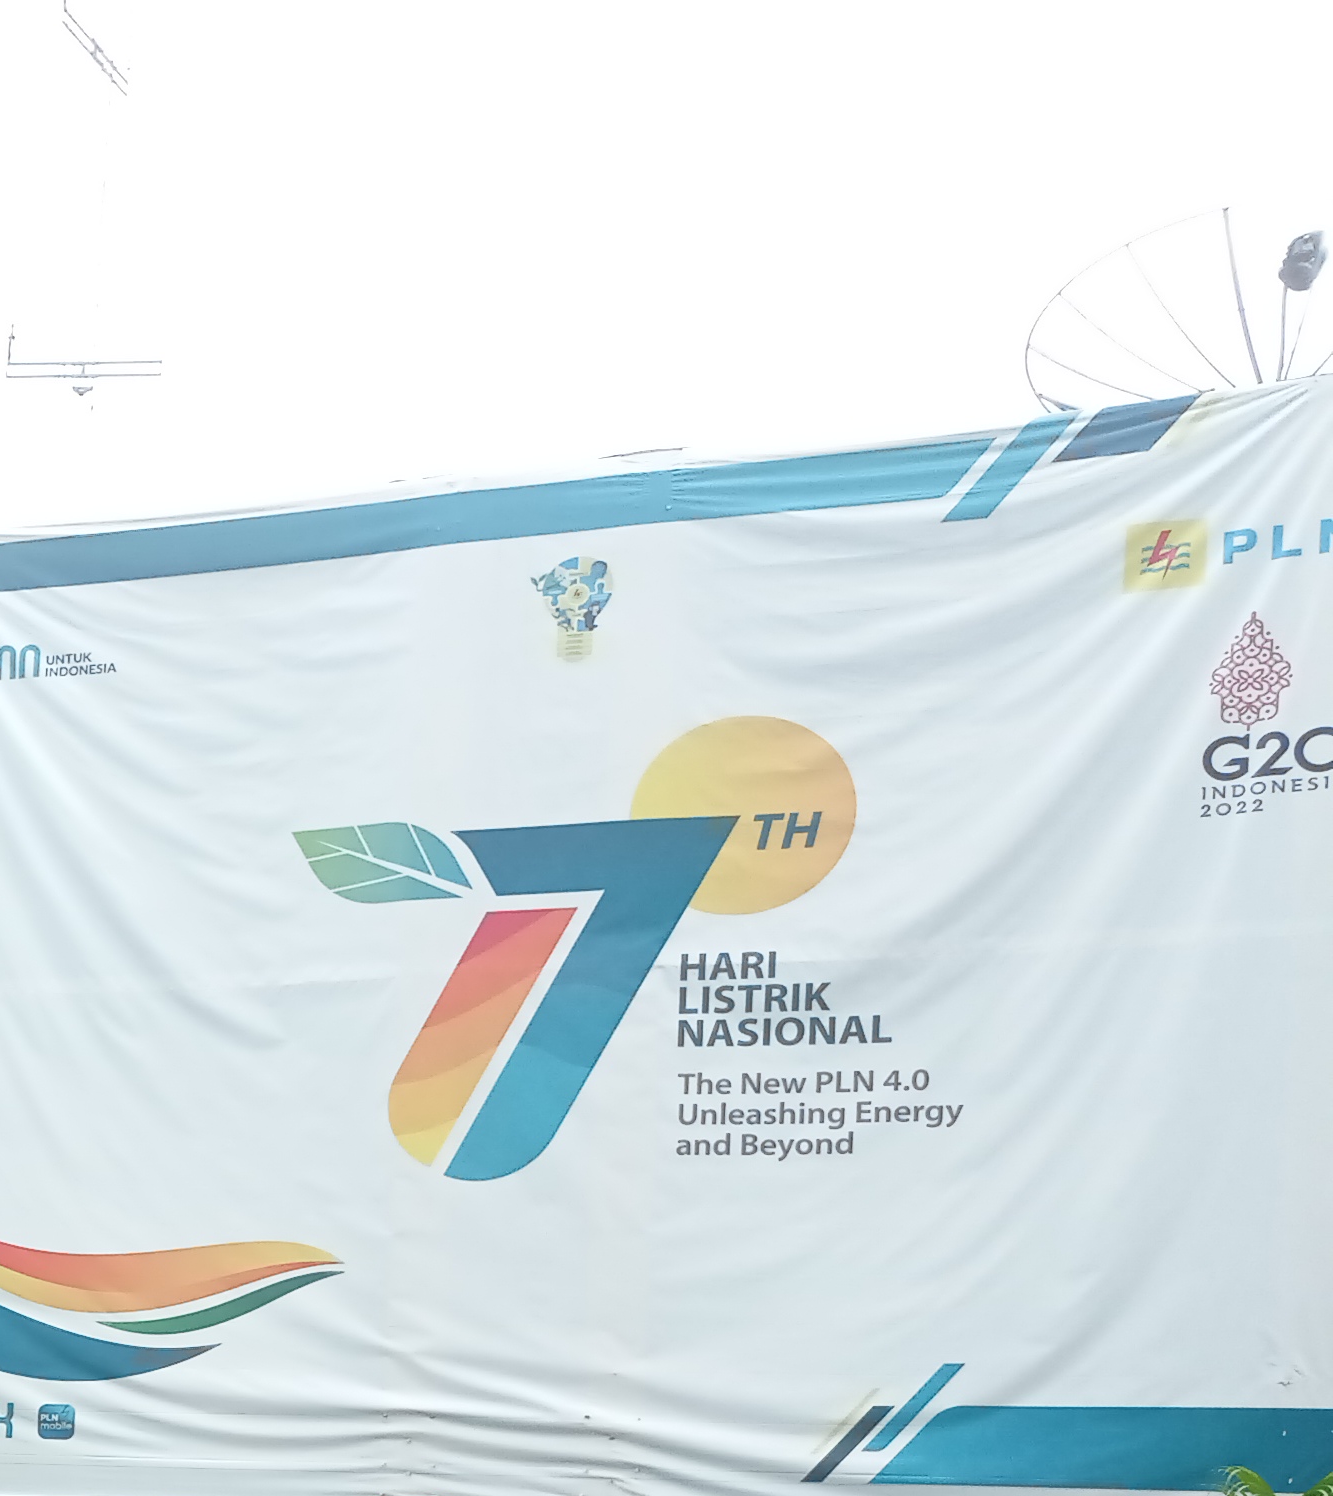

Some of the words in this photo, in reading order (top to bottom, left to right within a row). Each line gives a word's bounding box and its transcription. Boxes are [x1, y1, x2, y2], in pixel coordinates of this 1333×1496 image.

[44, 663, 117, 678] INDONESIA
[46, 652, 92, 666] UNTUK
[1199, 798, 1264, 818] 2022
[679, 951, 777, 981] HARI
[678, 981, 831, 1015] LISTRIK
[677, 1014, 893, 1047] NASIONAL
[678, 1072, 732, 1095] The
[740, 1072, 807, 1094] New
[815, 1070, 874, 1093] PLN
[882, 1069, 930, 1091] 4.0
[677, 1101, 846, 1130] Unleashing
[855, 1100, 964, 1128] Energy
[676, 1132, 731, 1156] and
[740, 1131, 854, 1161] Beyond
[39, 1413, 59, 1422] PLN
[39, 1421, 73, 1431] mobile
